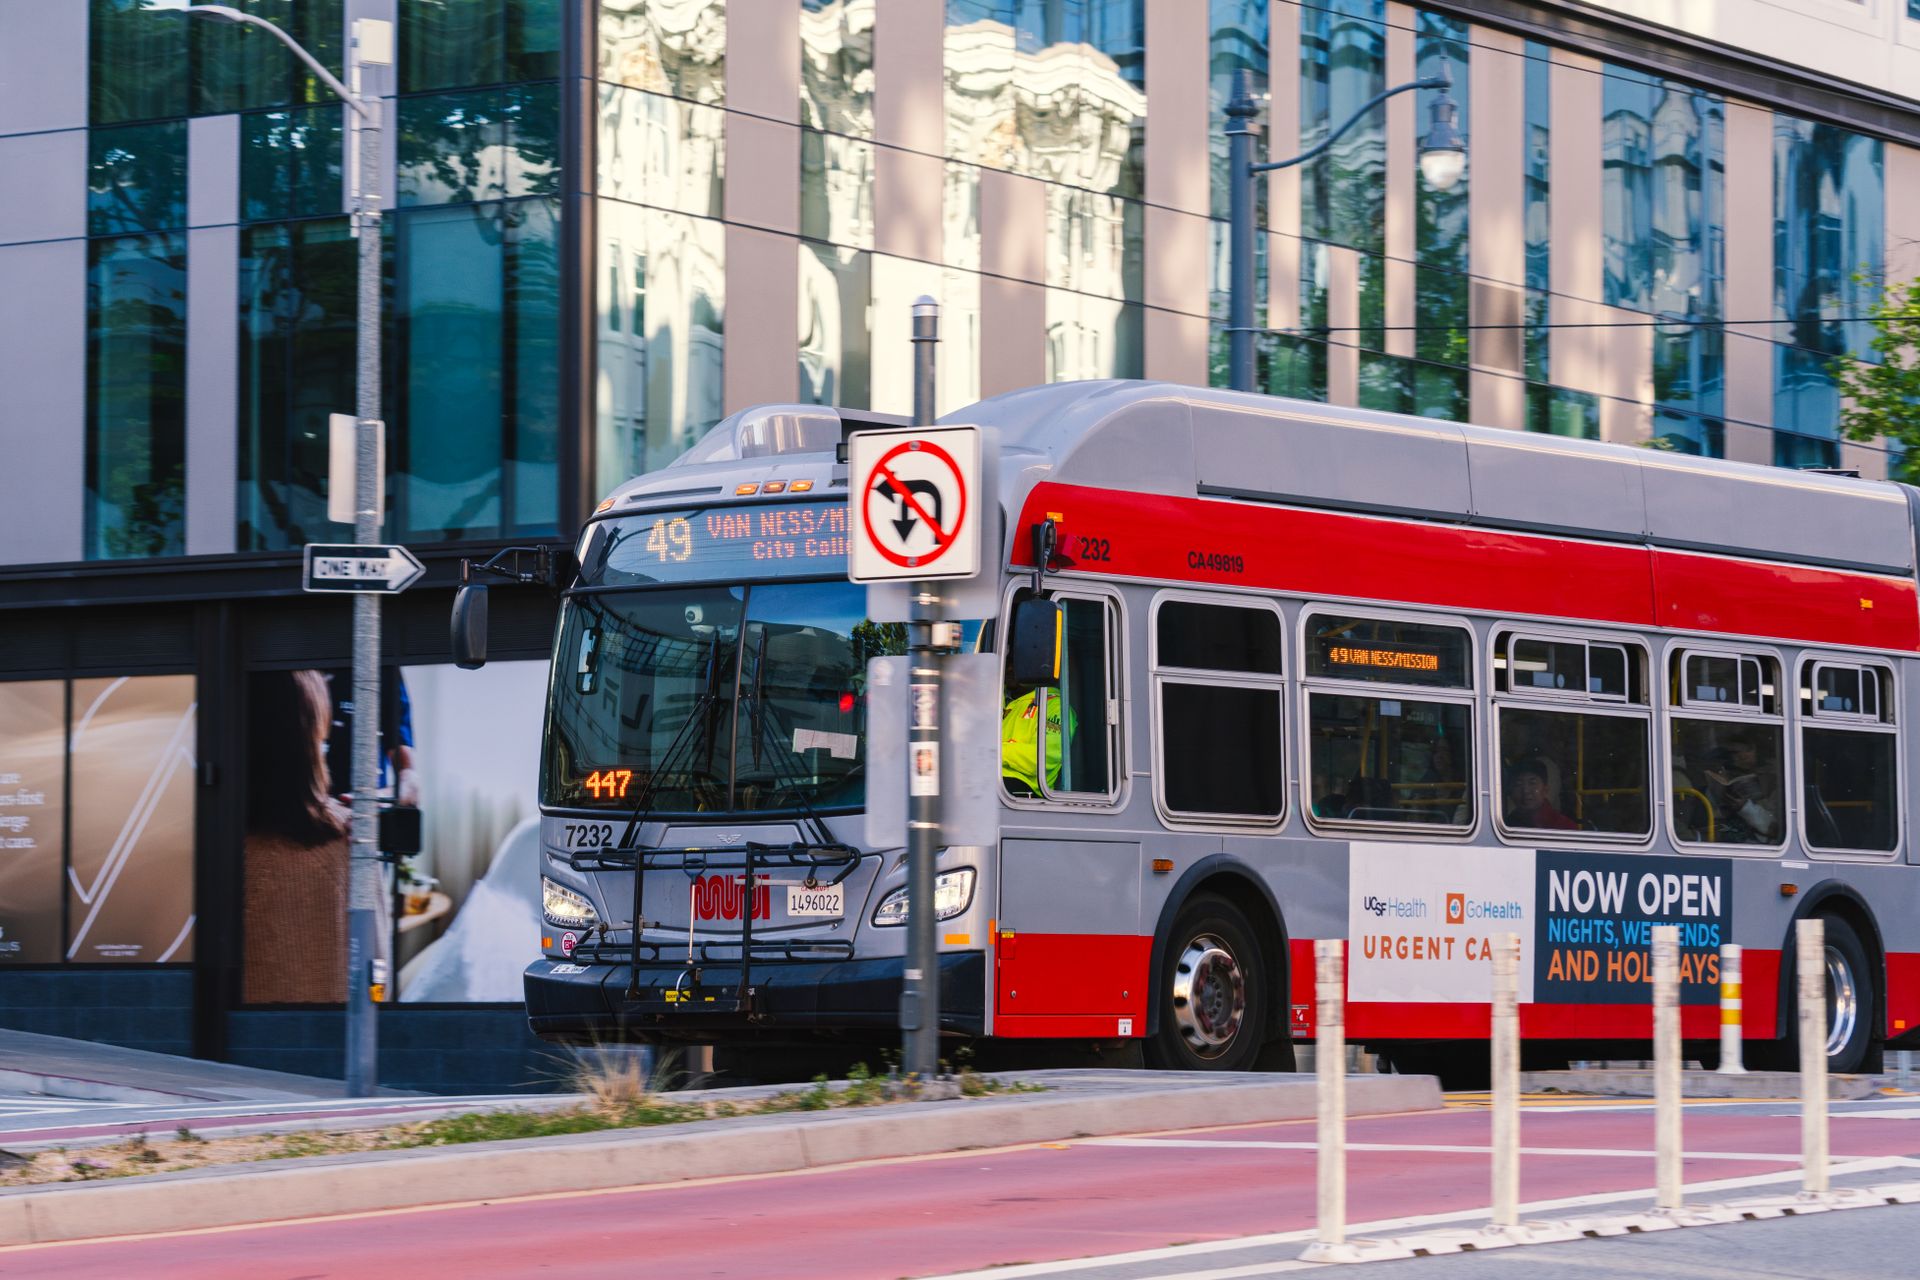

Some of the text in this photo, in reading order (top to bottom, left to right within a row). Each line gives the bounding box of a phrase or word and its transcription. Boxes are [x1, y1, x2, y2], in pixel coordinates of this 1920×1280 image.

[645, 517, 692, 562] 49
[707, 513, 751, 539] VAN
[753, 540, 796, 560] City
[1187, 551, 1244, 573] CA49819
[1329, 647, 1349, 664] 49
[1370, 650, 1438, 671] NESS/MISSION
[585, 769, 632, 799] 447
[565, 824, 613, 848] 7232
[791, 894, 840, 911] 1496022
[1548, 869, 1721, 917] NOW OPEN
[1388, 898, 1427, 918] Health
[1466, 900, 1522, 919] GoHealth
[1548, 917, 1620, 949] NIGHTS,
[1363, 935, 1521, 961] URGENT CAE
[1547, 948, 1720, 985] AND HOLAYS
